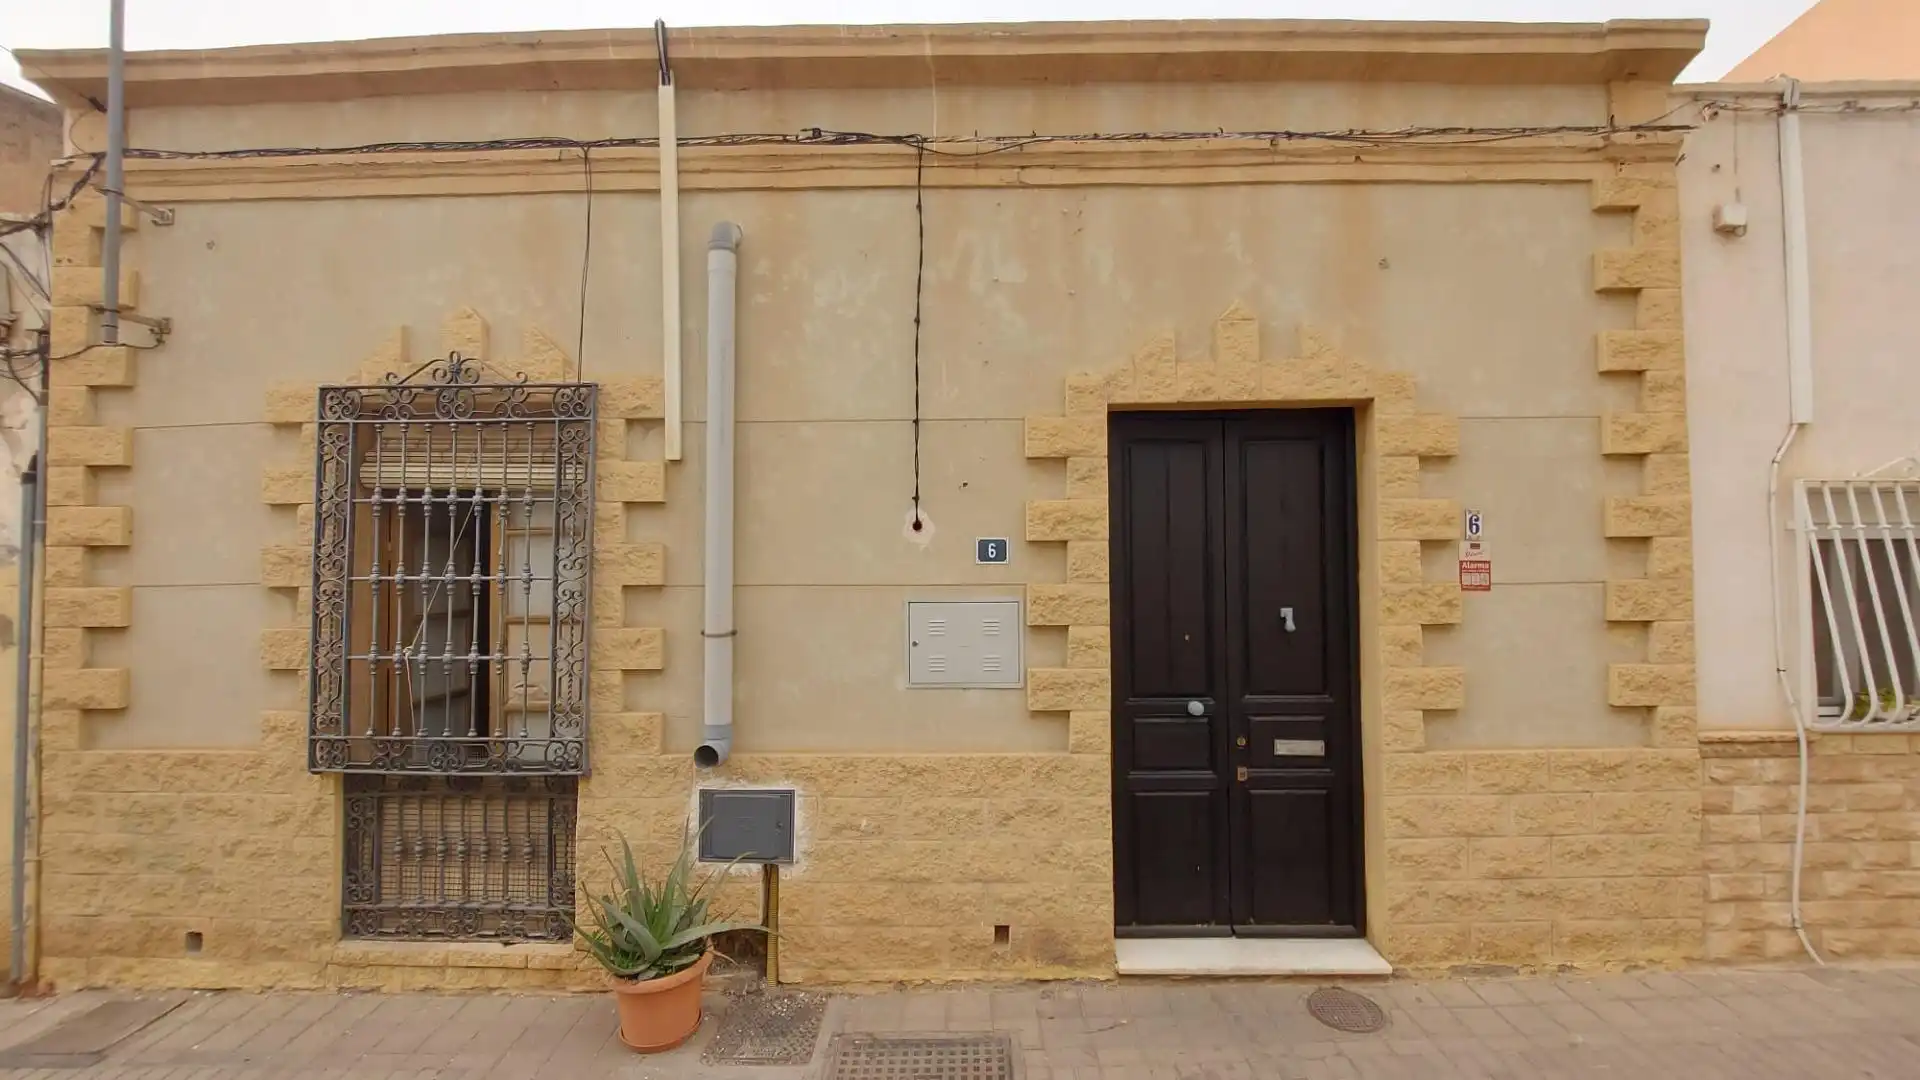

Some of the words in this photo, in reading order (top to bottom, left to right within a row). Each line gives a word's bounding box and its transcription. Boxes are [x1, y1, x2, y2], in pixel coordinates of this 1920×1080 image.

[1469, 514, 1480, 535] 6
[988, 543, 996, 559] 6
[1462, 561, 1490, 569] Alarma
